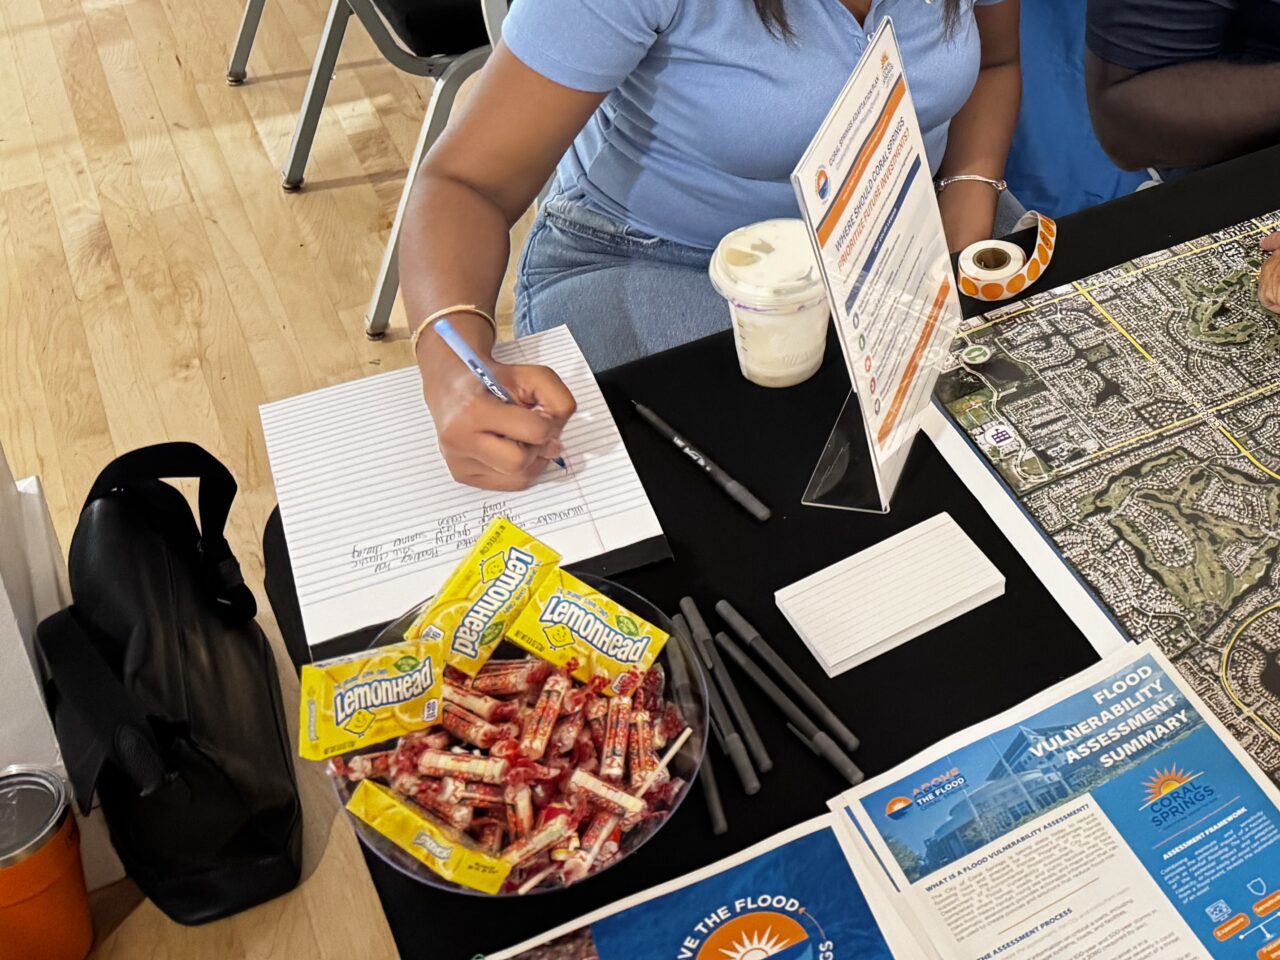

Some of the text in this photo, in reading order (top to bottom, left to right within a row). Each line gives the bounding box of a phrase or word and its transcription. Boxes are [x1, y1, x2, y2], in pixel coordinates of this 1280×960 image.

[834, 215, 856, 253] WHERE
[853, 179, 874, 220] SHOULD
[871, 150, 889, 183] CORAL
[863, 188, 884, 224] FUTURE
[1092, 665, 1153, 705] FLOOD
[1029, 678, 1164, 758] VULNERABILITY
[1065, 694, 1177, 764] ASSESSMENT
[1100, 709, 1189, 768] SUMMARY
[916, 775, 964, 806] THE FLOOD
[1151, 785, 1200, 817] CORAL
[1151, 786, 1215, 829] SPRINGS
[924, 802, 1090, 893] WHAT IS A FLOOD VULNERABILITY ASSESSMENT?
[1161, 805, 1248, 861] ASSESSMENT FRAMEWORK
[695, 894, 801, 935] THE FLOOD
[992, 926, 1040, 956] ASSESSMENT
[1040, 906, 1073, 929] PROCESS
